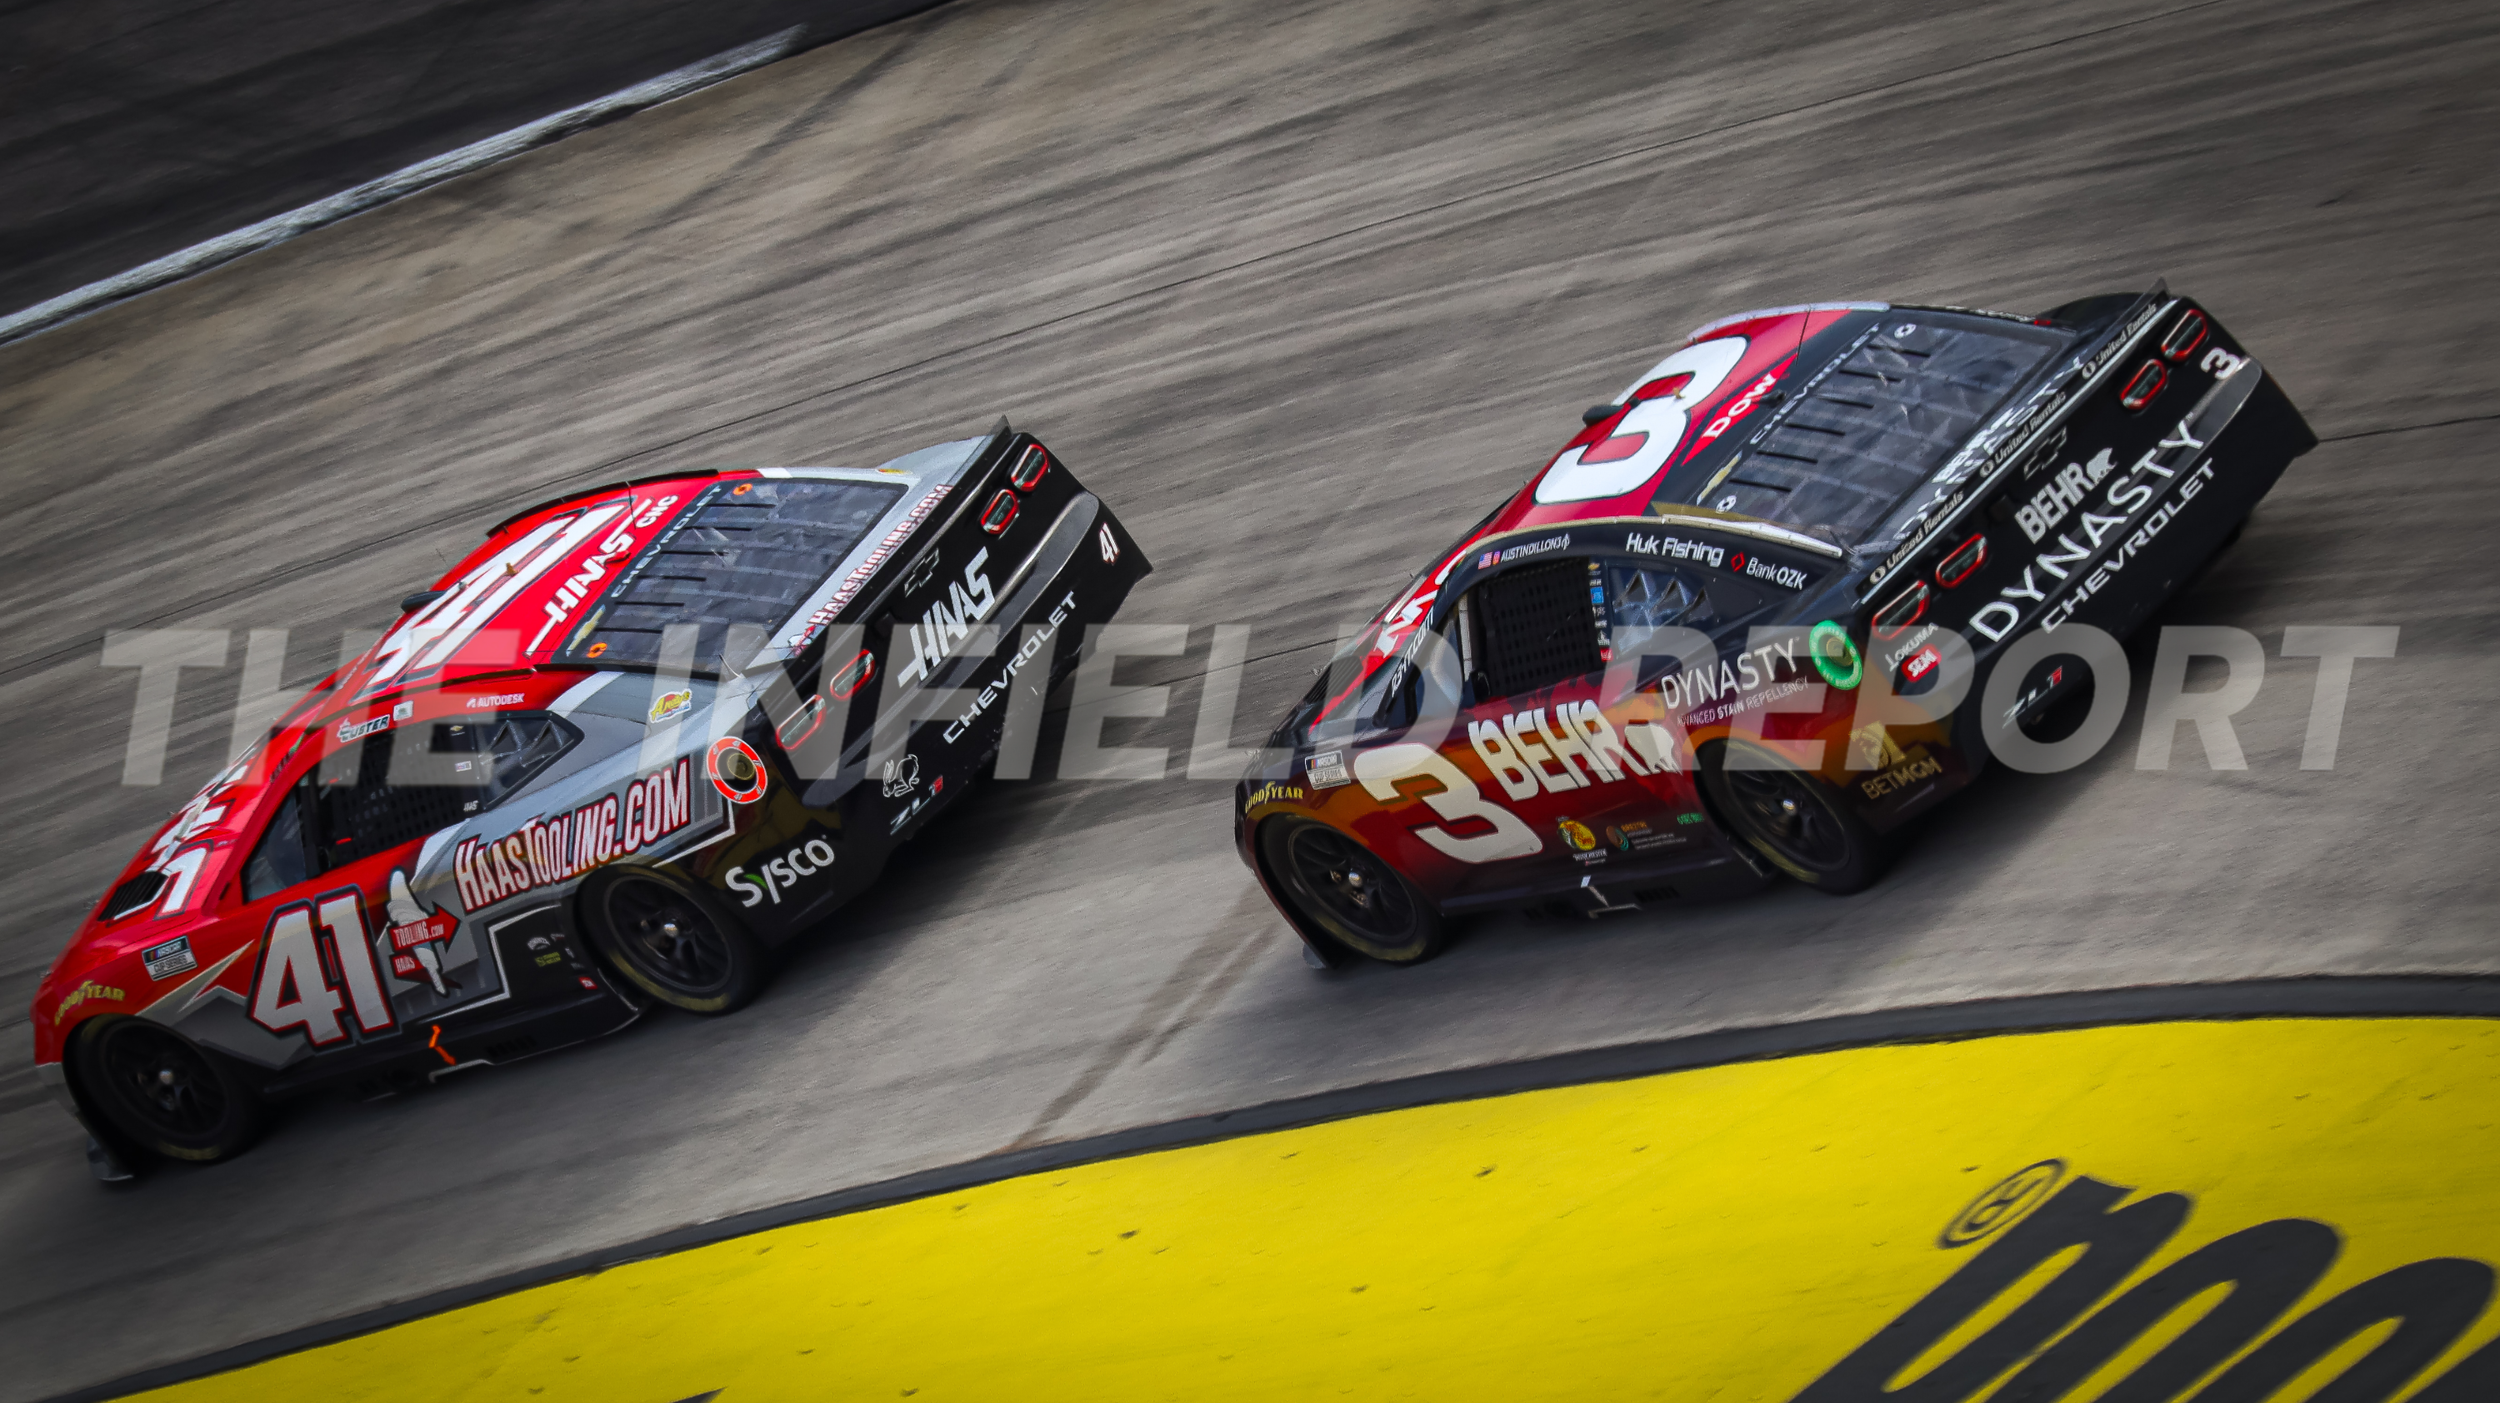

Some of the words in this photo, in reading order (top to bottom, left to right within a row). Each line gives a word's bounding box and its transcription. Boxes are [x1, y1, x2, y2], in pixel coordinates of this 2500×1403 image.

[1749, 322, 1880, 444] CHEVROLET
[2200, 347, 2241, 380] 3
[1534, 334, 1751, 505] 3
[611, 485, 720, 598] CHEVROLET
[636, 495, 679, 528] CNC
[1099, 522, 1119, 563] 41
[1625, 532, 1660, 556] Huk
[1661, 537, 1725, 568] Fishing
[1969, 419, 2205, 643] DYNASTY
[2014, 462, 2093, 544] BEHR
[2040, 457, 2214, 634] CHEVROLET
[897, 545, 995, 688] HAAS
[943, 590, 1075, 744] CHEVROLET
[478, 693, 525, 708] AUTODESK
[1661, 638, 1798, 710] DYNASTY
[1717, 700, 1745, 721] STAIN
[1746, 676, 1809, 710] REPELLENCY
[1467, 699, 1649, 802] BEHR
[1860, 755, 1943, 800] BETMGM
[1353, 742, 1543, 864] 3
[249, 889, 397, 1049] 41
